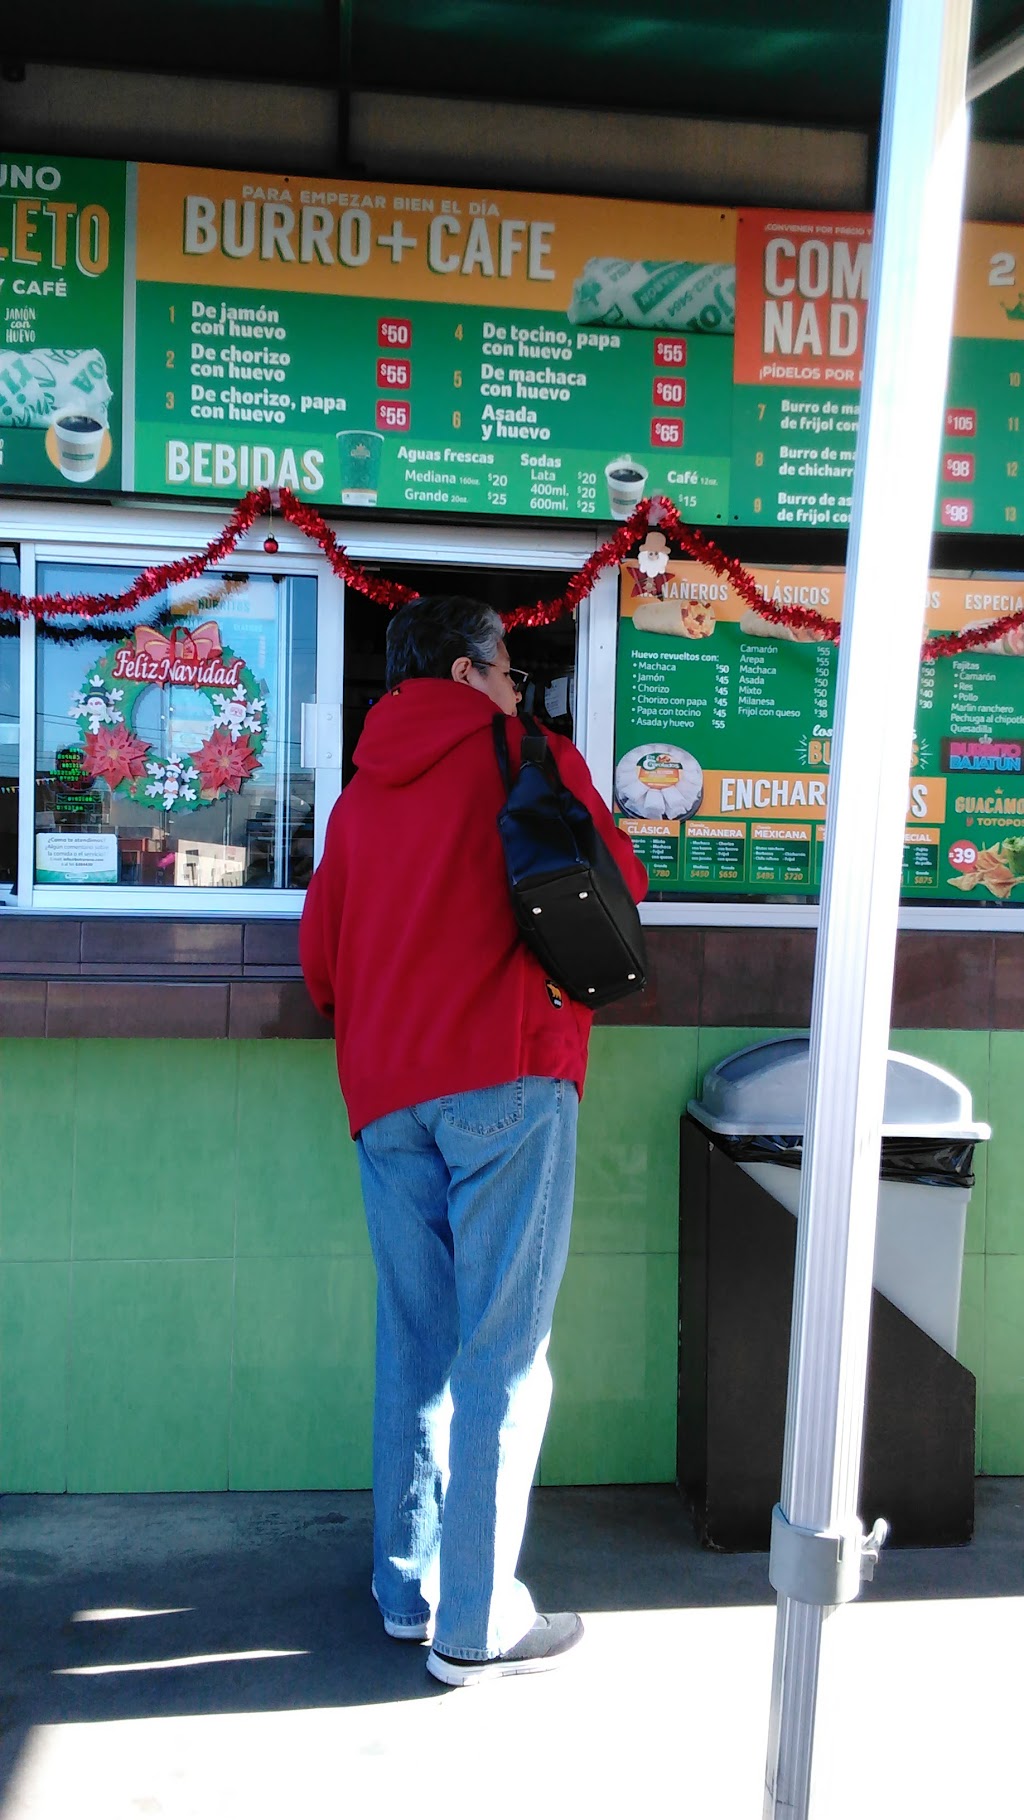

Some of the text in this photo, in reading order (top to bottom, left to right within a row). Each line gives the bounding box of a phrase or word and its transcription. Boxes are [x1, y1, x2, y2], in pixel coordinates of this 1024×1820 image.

[242, 185, 499, 217] PARA EMPEZAR BIEN EL DÍA
[0, 200, 110, 277] ETO
[815, 225, 833, 234] POR
[835, 226, 865, 235] PRECIO
[764, 237, 873, 300] COM
[988, 251, 1016, 287] 2
[12, 278, 67, 297] CAFÉ
[4, 305, 36, 321] JAMÓN
[169, 301, 279, 324] 1 De jamón
[10, 320, 31, 329] con
[191, 320, 286, 340] con huevo
[763, 299, 859, 358] NAD
[6, 328, 36, 344] HUEVO
[381, 323, 408, 344] $50
[454, 322, 620, 351] 4 De tocino, papa
[166, 342, 291, 369] 2 De chorizo
[482, 340, 573, 361] con huevo
[657, 343, 683, 363] $55
[191, 362, 286, 382] con huevo
[380, 363, 407, 385] $55
[453, 363, 587, 388] 5 De machaca
[825, 368, 854, 381] POR
[165, 384, 347, 415] 3 De chorizo, papa
[480, 381, 571, 402] con huevo
[656, 382, 683, 402] $60
[191, 403, 286, 424] con huevo
[380, 405, 407, 426] $55
[452, 404, 538, 429] 6 Asada
[758, 403, 766, 420] 7
[781, 399, 820, 414] Burro
[822, 400, 839, 414] de
[481, 421, 551, 441] y huevo
[655, 423, 679, 442] $65
[780, 416, 834, 434] de frijol
[397, 446, 495, 464] Aguas frescas
[520, 453, 562, 468] Sodas
[755, 451, 764, 467] 8
[780, 445, 818, 460] Burro
[820, 446, 837, 460] de
[166, 440, 324, 493] BEBIDAS
[779, 461, 854, 478] de chicharr
[947, 459, 970, 477] $98
[1006, 461, 1018, 478] 12
[404, 469, 508, 487] Mediana $20
[530, 468, 597, 485] Lata $20
[667, 470, 698, 485] Café
[404, 487, 449, 503] Grande
[487, 492, 507, 506] $25
[577, 485, 596, 499] $20
[679, 494, 697, 507] $15
[778, 491, 816, 505] Burro
[819, 492, 836, 506] de
[577, 500, 596, 514] $25
[945, 504, 968, 523] $98
[776, 508, 831, 525] de frijol
[965, 593, 1024, 612] ESPECIA
[631, 650, 719, 662] Huevo revueltos con:
[740, 644, 778, 654] Camarón
[638, 661, 730, 674] Machaca $50
[740, 654, 765, 665] Arepa
[952, 661, 980, 672] Fajitas
[637, 672, 729, 685] Jamón $45
[739, 665, 777, 675] Machaca
[959, 672, 996, 681] Camarón
[739, 675, 765, 685] Asada
[959, 682, 973, 691] Res
[637, 683, 729, 696] Chorizo $45
[738, 685, 763, 695] Mixto
[958, 692, 978, 702] Pollo
[637, 694, 728, 708] Chorizo con papa $45
[738, 696, 775, 706] Milanesa
[951, 703, 1014, 714] Marlin ranchero
[636, 705, 727, 718] Papa con tocino $45
[738, 706, 801, 718] Frijol con queso
[950, 713, 994, 724] Pechuga al
[636, 716, 726, 729] Asada y huevo $55
[950, 723, 992, 734] Quesadilla
[720, 778, 826, 812] ENCHAR
[955, 796, 1024, 815] GUACAMO
[627, 824, 671, 835] CLÁSICA
[687, 826, 743, 837] MAÑANERA
[754, 829, 807, 839] MEXICANA
